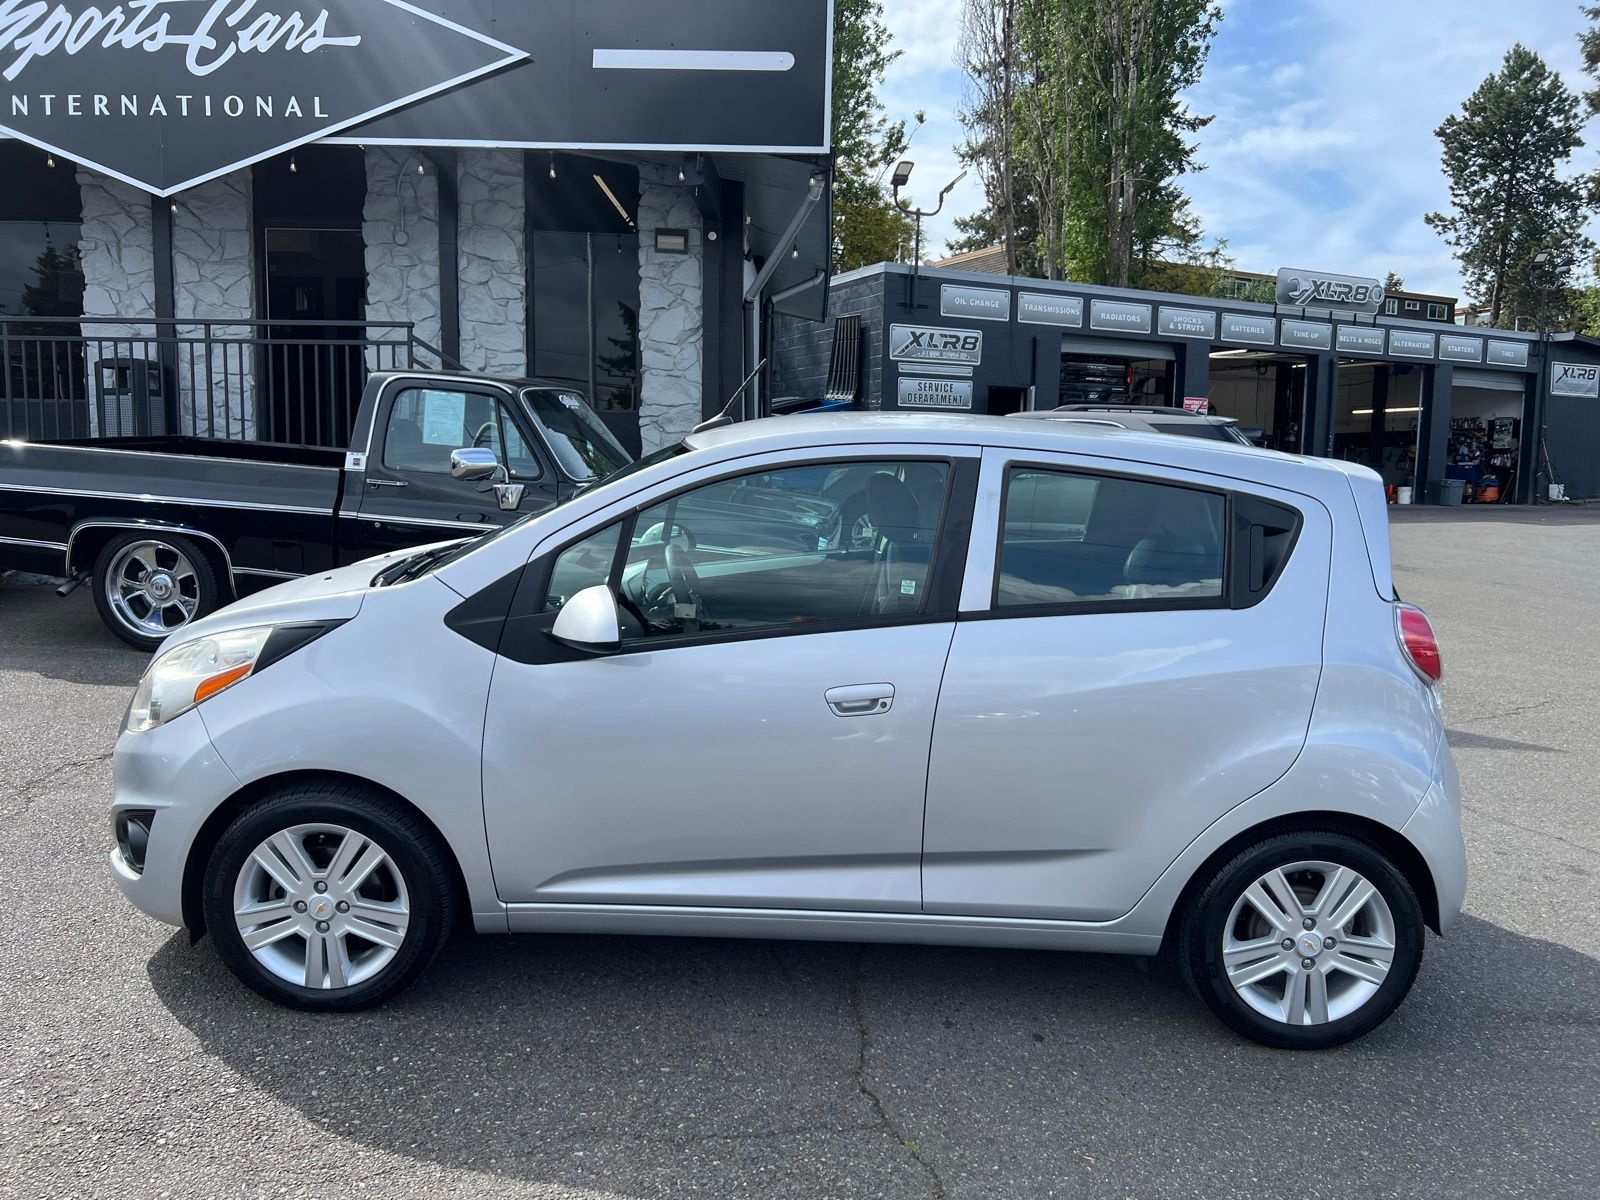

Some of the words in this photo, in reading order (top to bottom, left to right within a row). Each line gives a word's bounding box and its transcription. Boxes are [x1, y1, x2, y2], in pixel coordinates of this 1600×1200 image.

[186, 0, 361, 76] Cars
[1296, 279, 1370, 305] XLR8
[954, 297, 967, 305] OIL
[969, 298, 1000, 308] CHANGE
[1024, 303, 1080, 316] TRANSMISSIONS
[1100, 312, 1141, 323] RADIATORS
[1173, 315, 1202, 324] SHOCKS
[1168, 322, 1175, 330] &
[1177, 323, 1205, 332] STRUTS
[1230, 324, 1265, 334] BATTERIES
[1293, 330, 1319, 339] TUNE-UP
[1339, 335, 1357, 344] BELTS
[1363, 337, 1382, 345] HOSES
[893, 330, 979, 356] XLR8
[1393, 340, 1430, 350] ALTERNATOR
[1447, 345, 1475, 354] STARTERS
[1555, 366, 1597, 384] XLR8
[917, 381, 954, 393] SERVICE
[907, 392, 963, 406] DEPARTMENT
